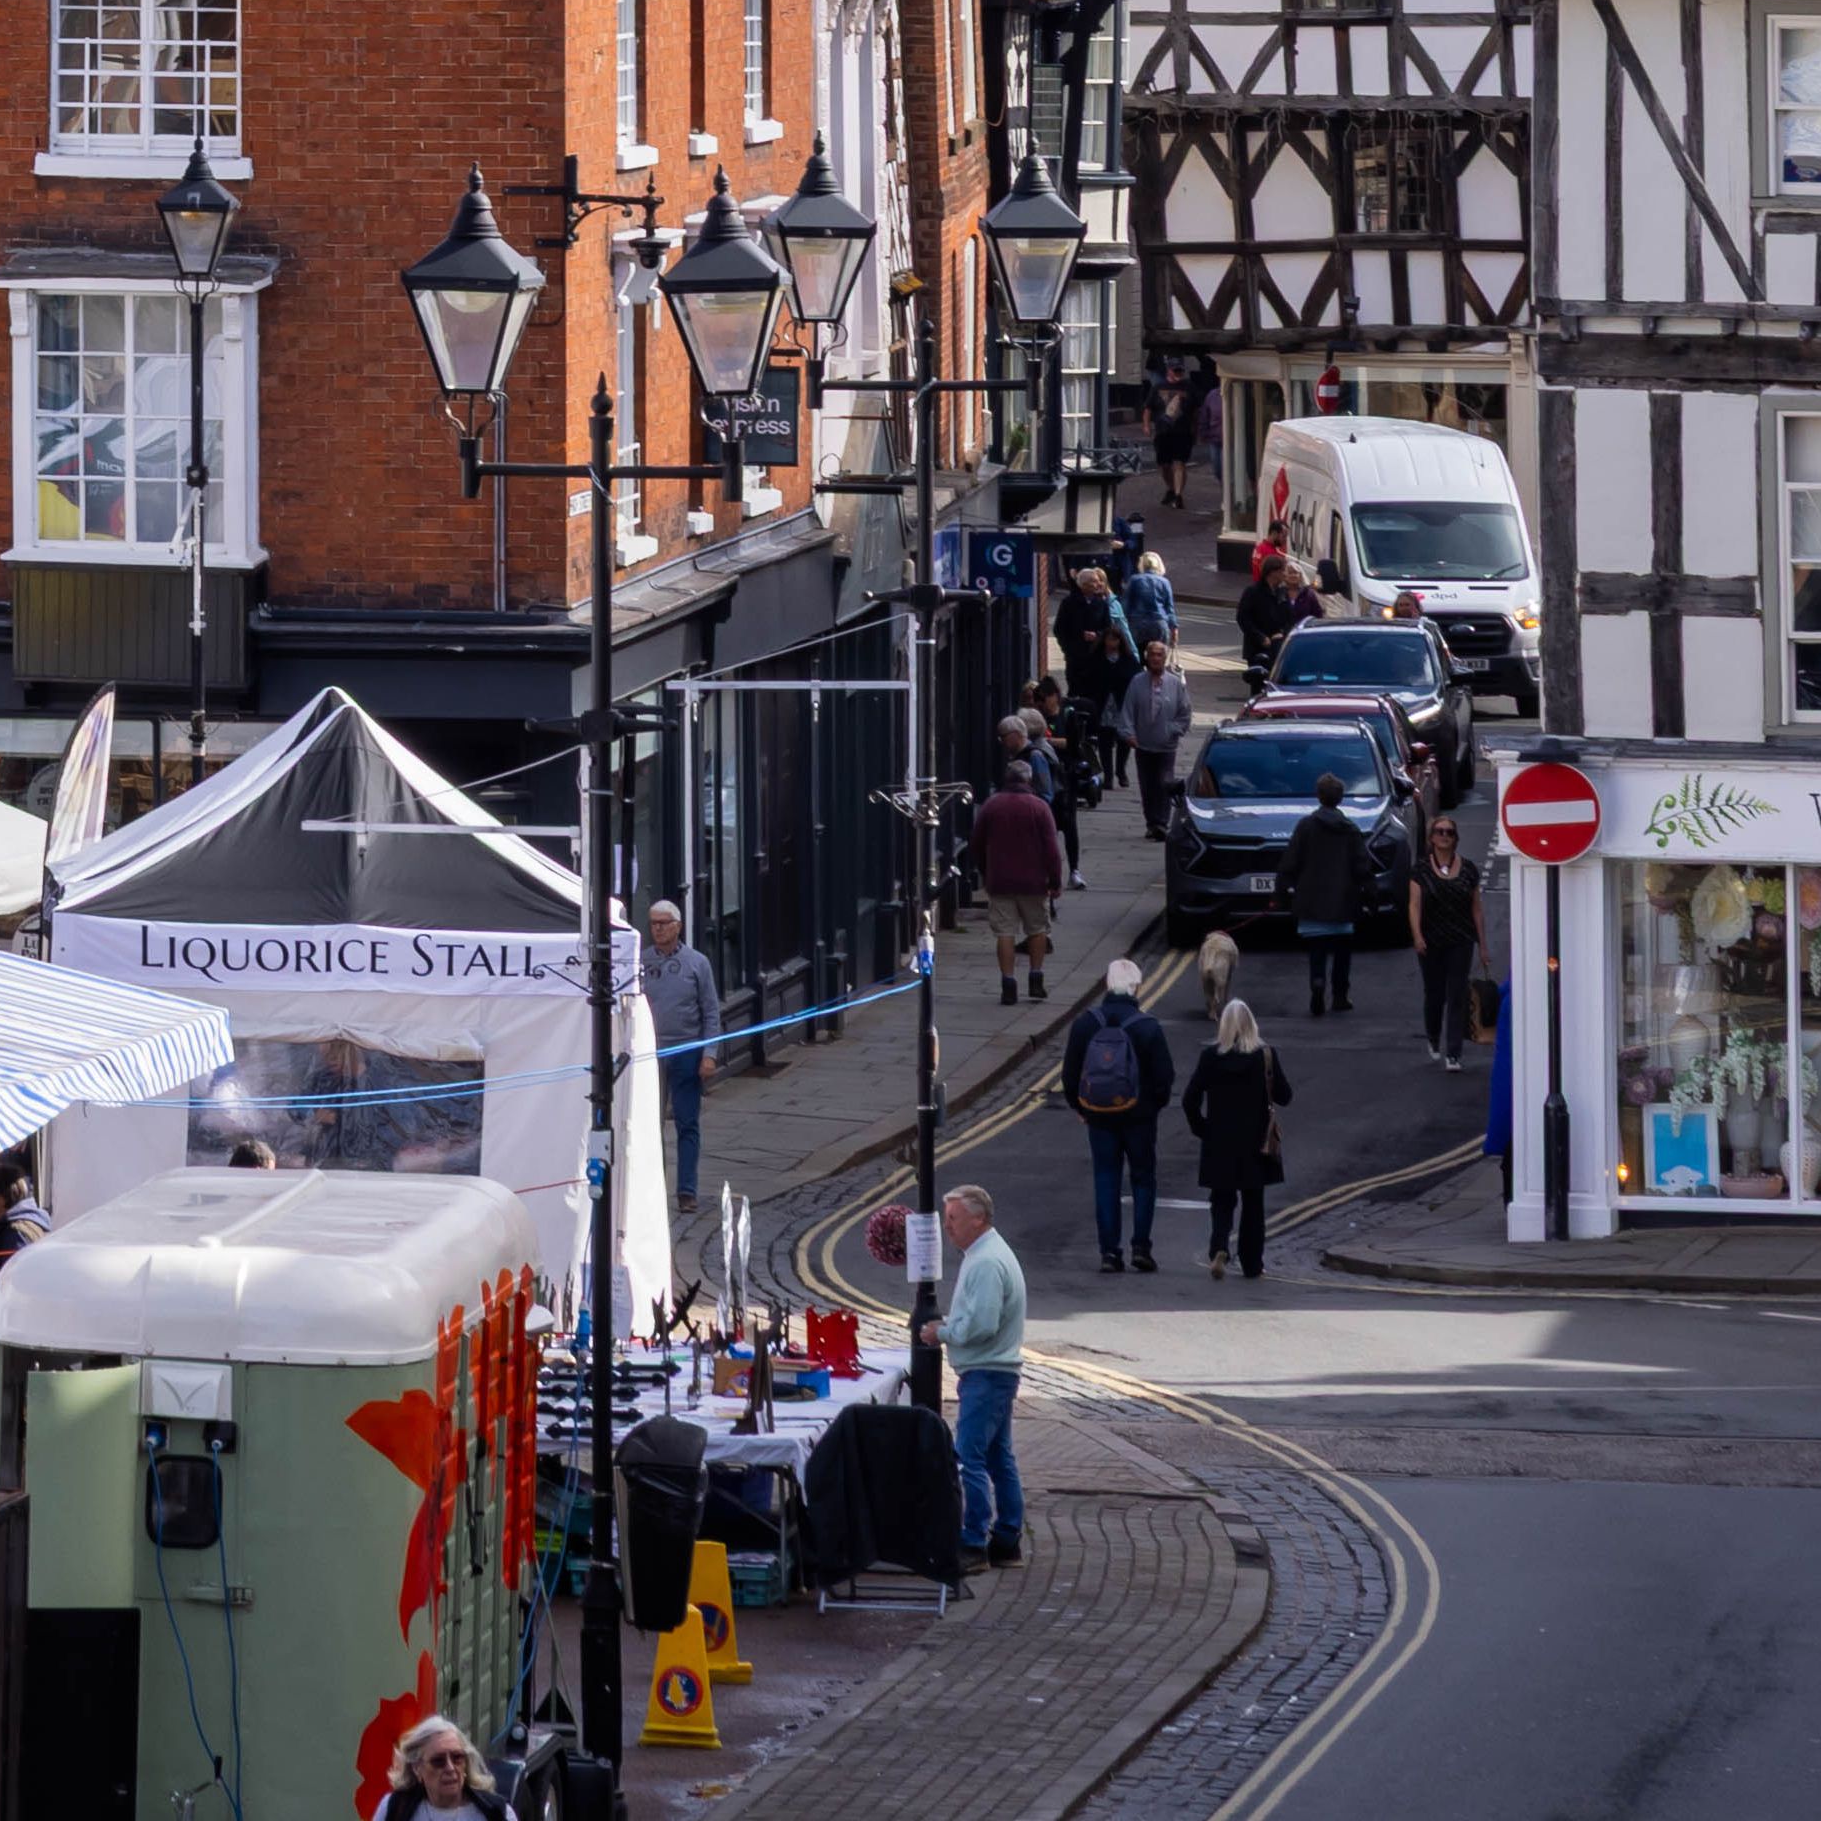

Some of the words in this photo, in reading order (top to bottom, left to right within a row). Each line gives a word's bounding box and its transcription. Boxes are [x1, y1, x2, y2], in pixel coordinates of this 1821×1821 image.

[1290, 493, 1317, 560] dpd
[1431, 592, 1458, 600] dpd
[140, 924, 390, 983] LIQUORICE
[410, 934, 539, 978] STALL
